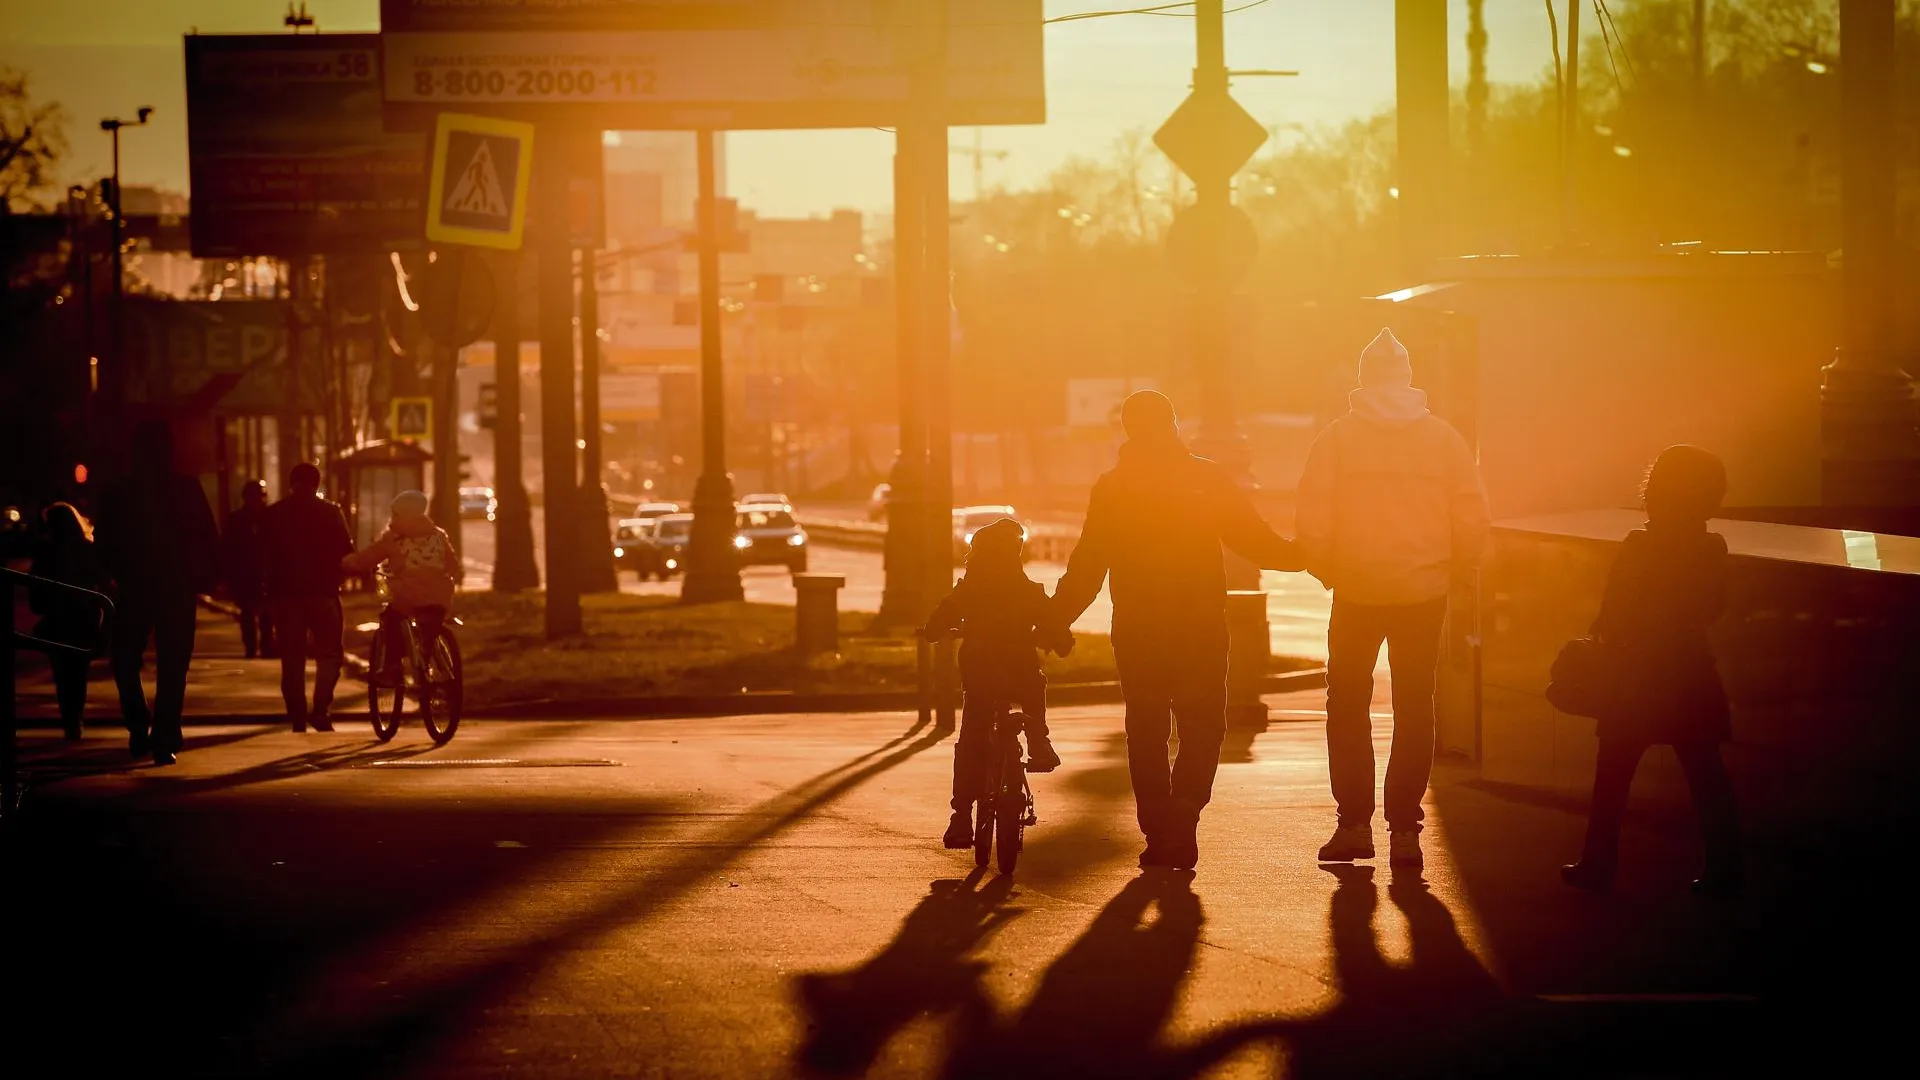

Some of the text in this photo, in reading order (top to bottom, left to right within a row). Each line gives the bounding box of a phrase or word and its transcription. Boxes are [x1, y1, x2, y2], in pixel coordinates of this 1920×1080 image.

[336, 53, 368, 77] 58
[413, 69, 658, 96] 8-800-2000-112
[148, 325, 290, 367] ВЕР
